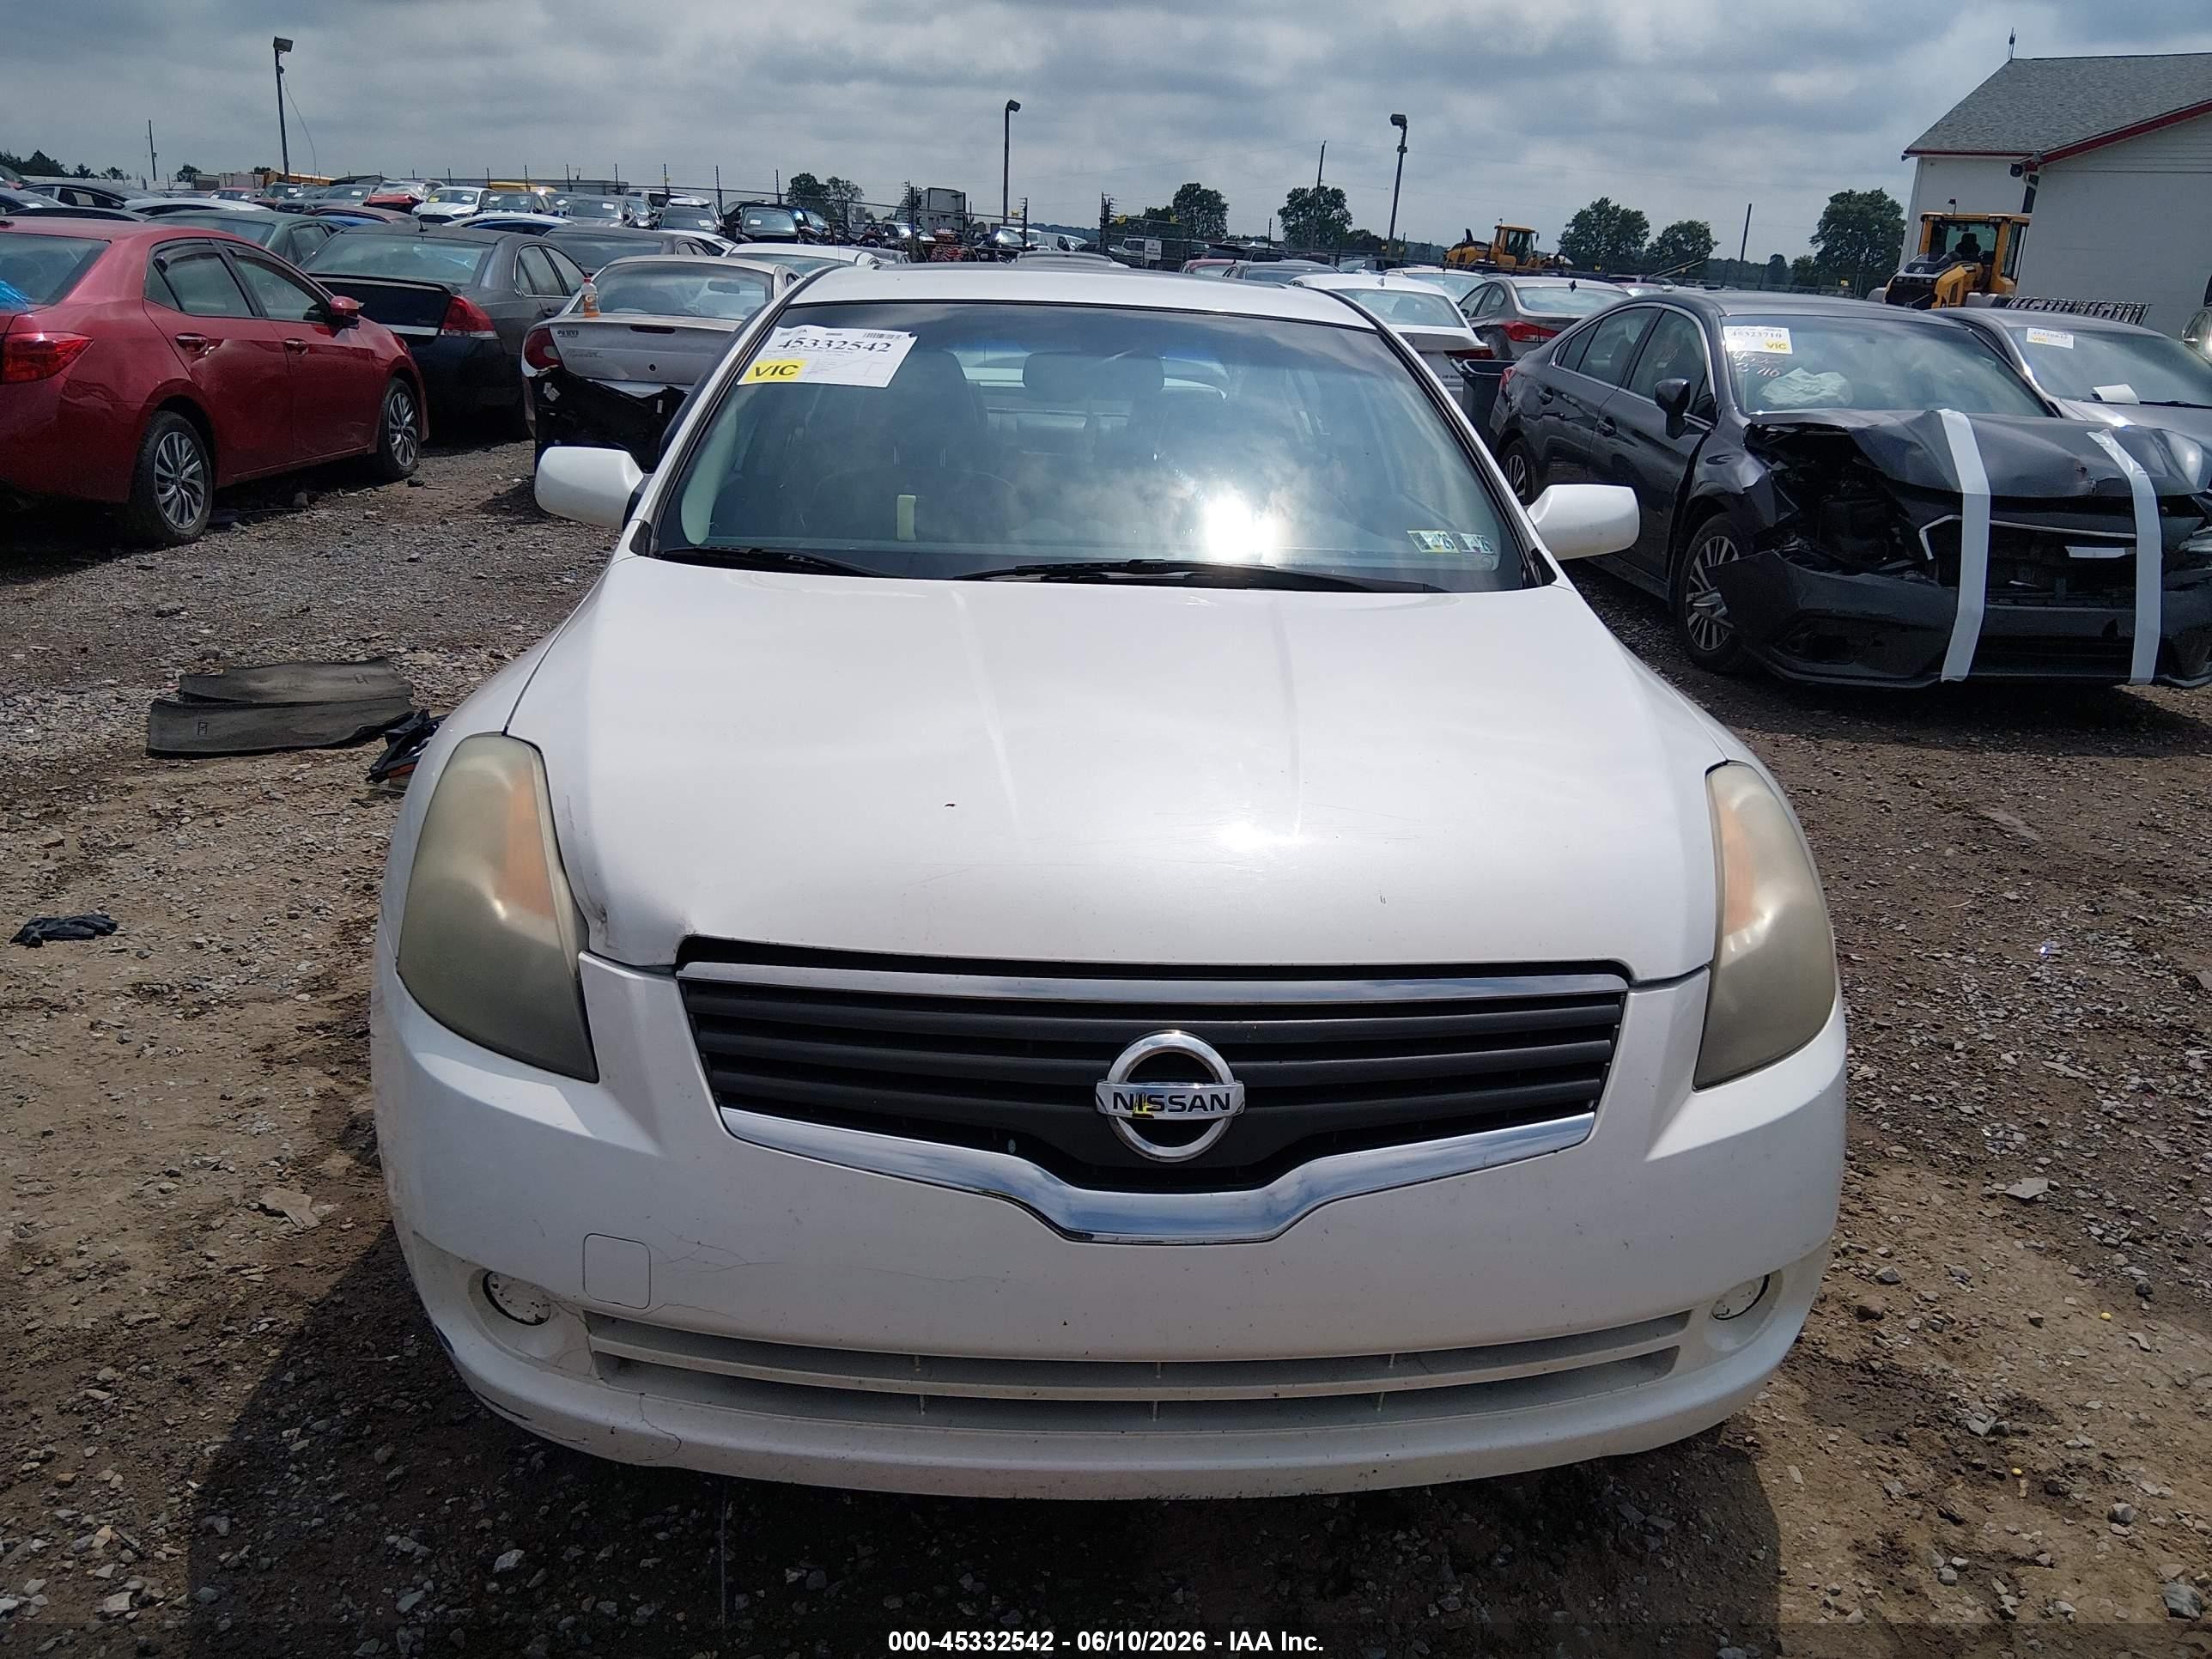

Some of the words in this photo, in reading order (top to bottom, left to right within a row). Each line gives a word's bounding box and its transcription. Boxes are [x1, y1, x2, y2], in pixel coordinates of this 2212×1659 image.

[777, 337, 891, 352] 45332542
[755, 364, 799, 377] VIC
[1113, 1092, 1230, 1112] NISSAN
